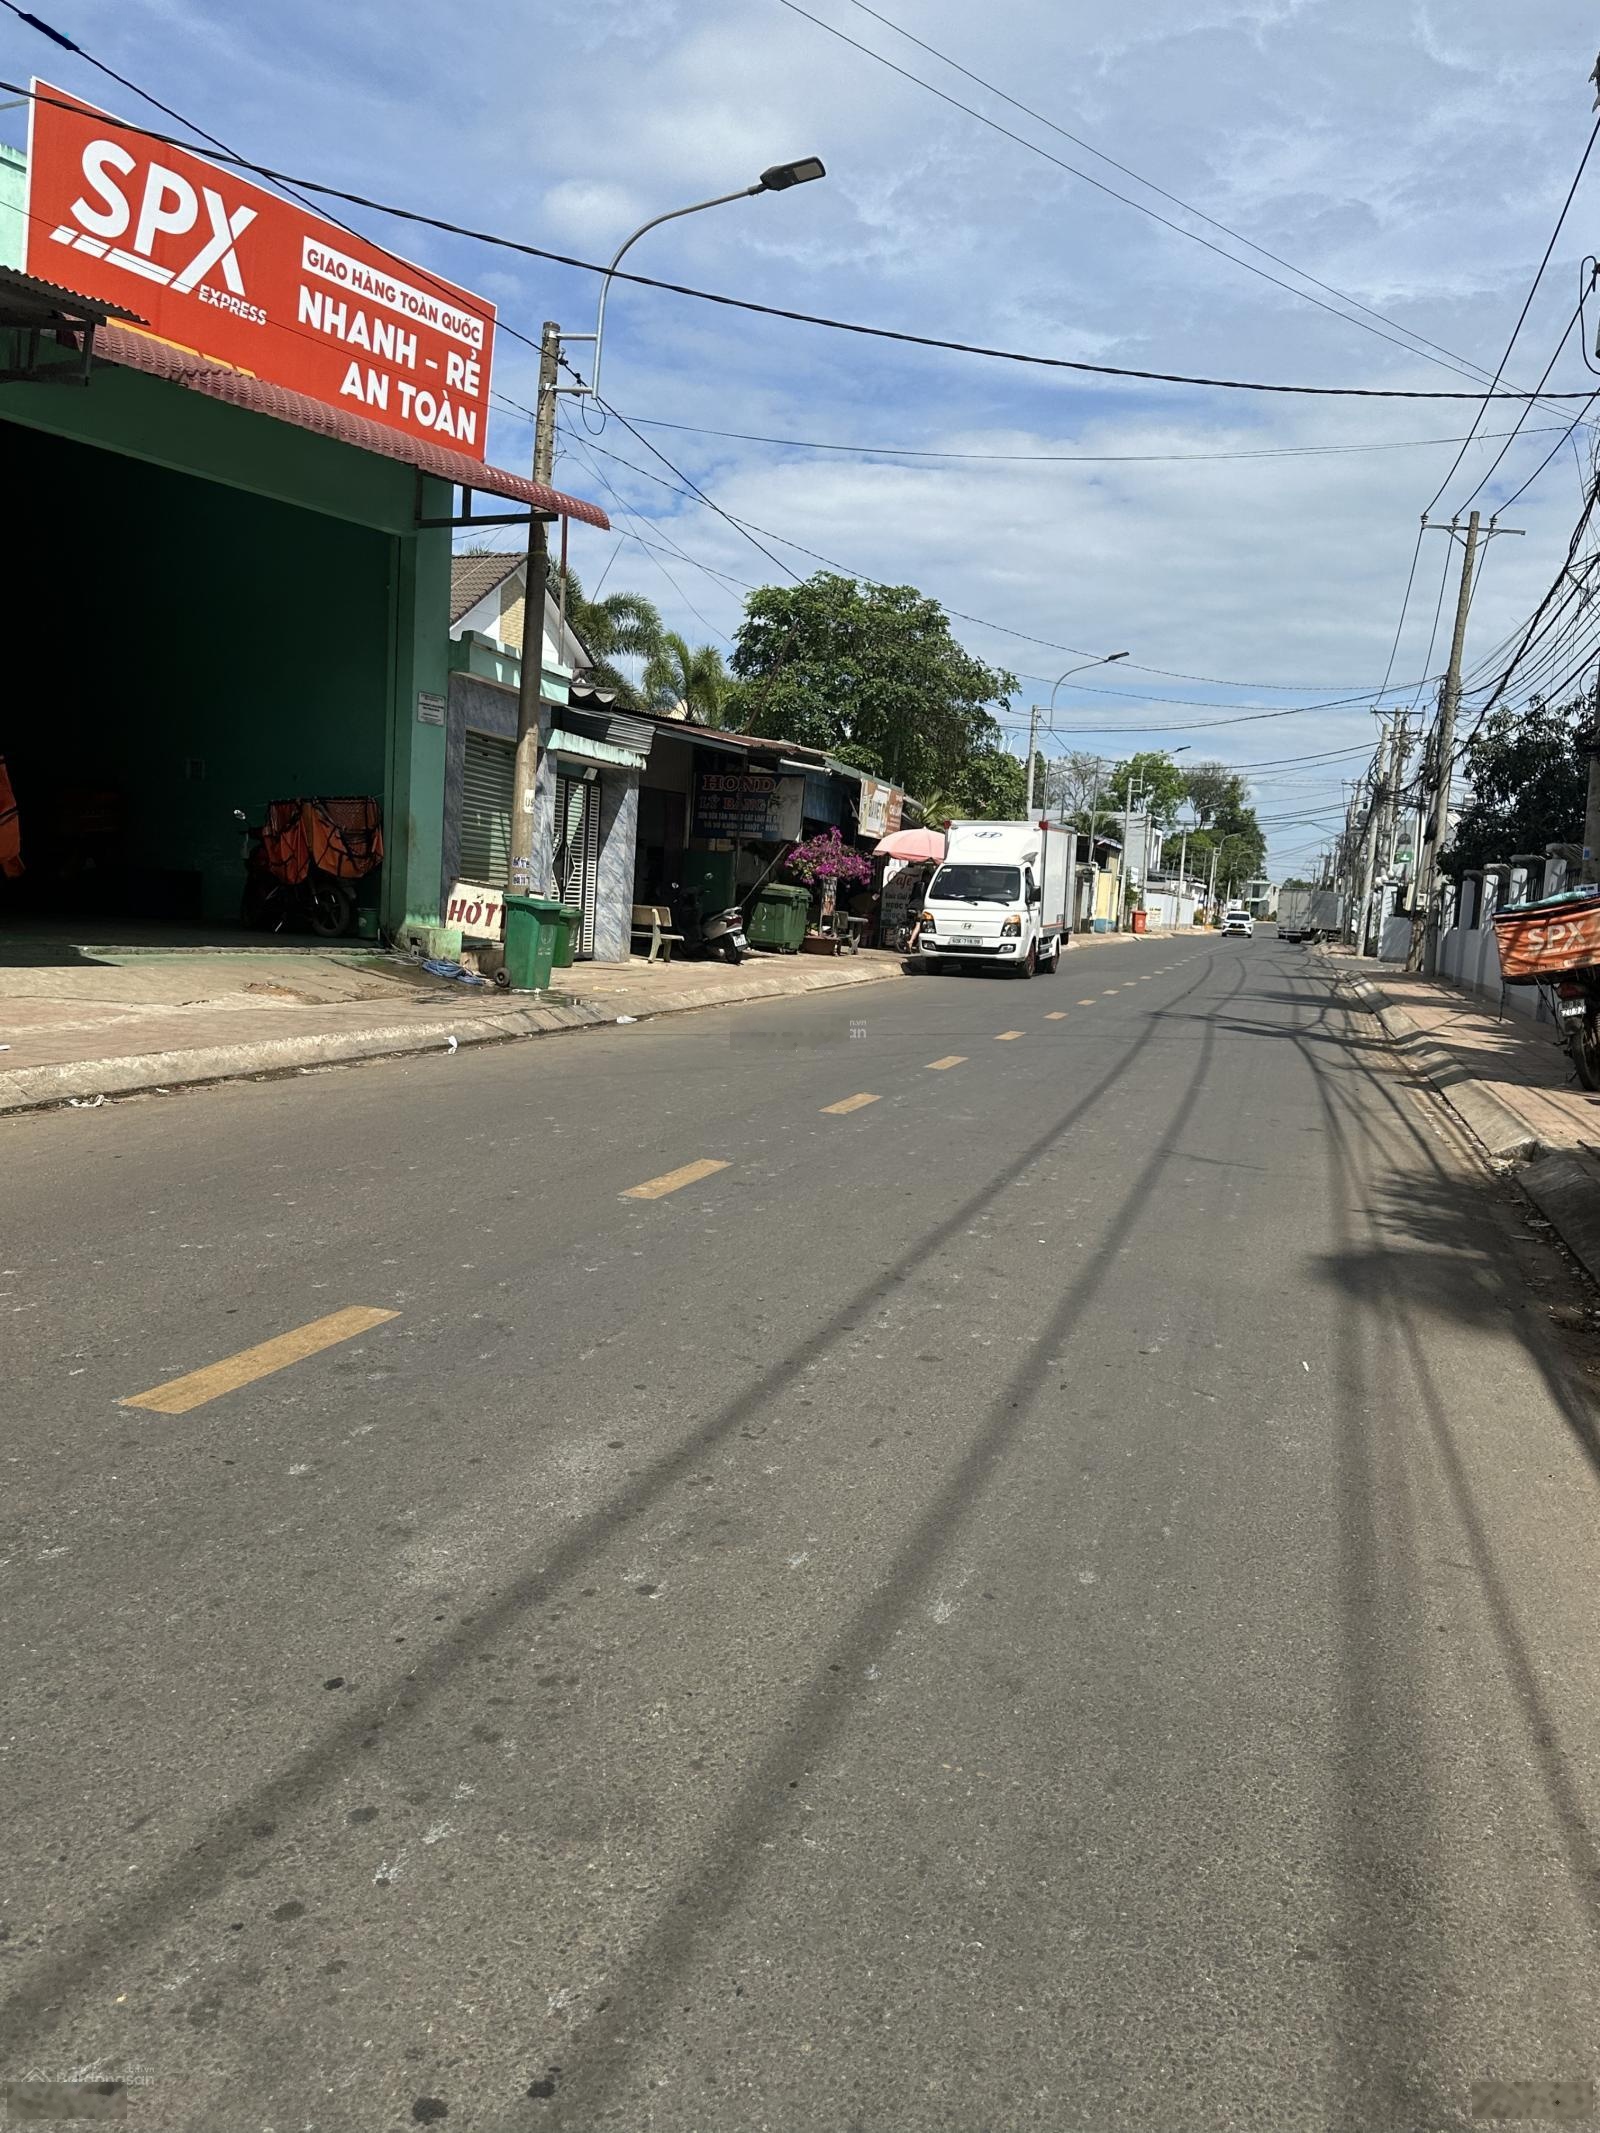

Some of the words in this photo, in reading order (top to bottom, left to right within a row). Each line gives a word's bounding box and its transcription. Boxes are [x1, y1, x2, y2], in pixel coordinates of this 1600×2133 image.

[70, 139, 259, 297] SPX
[198, 283, 267, 326] EXPRESS
[307, 248, 348, 281] GIAO
[352, 270, 397, 303] HÀNG
[400, 291, 439, 323] TOÀN
[441, 312, 481, 343] QUỐC
[298, 284, 418, 370] NHANH
[446, 348, 481, 398] RẺ
[339, 361, 390, 411] AN
[398, 380, 477, 445] TOÀN
[1527, 920, 1586, 951] SPX
